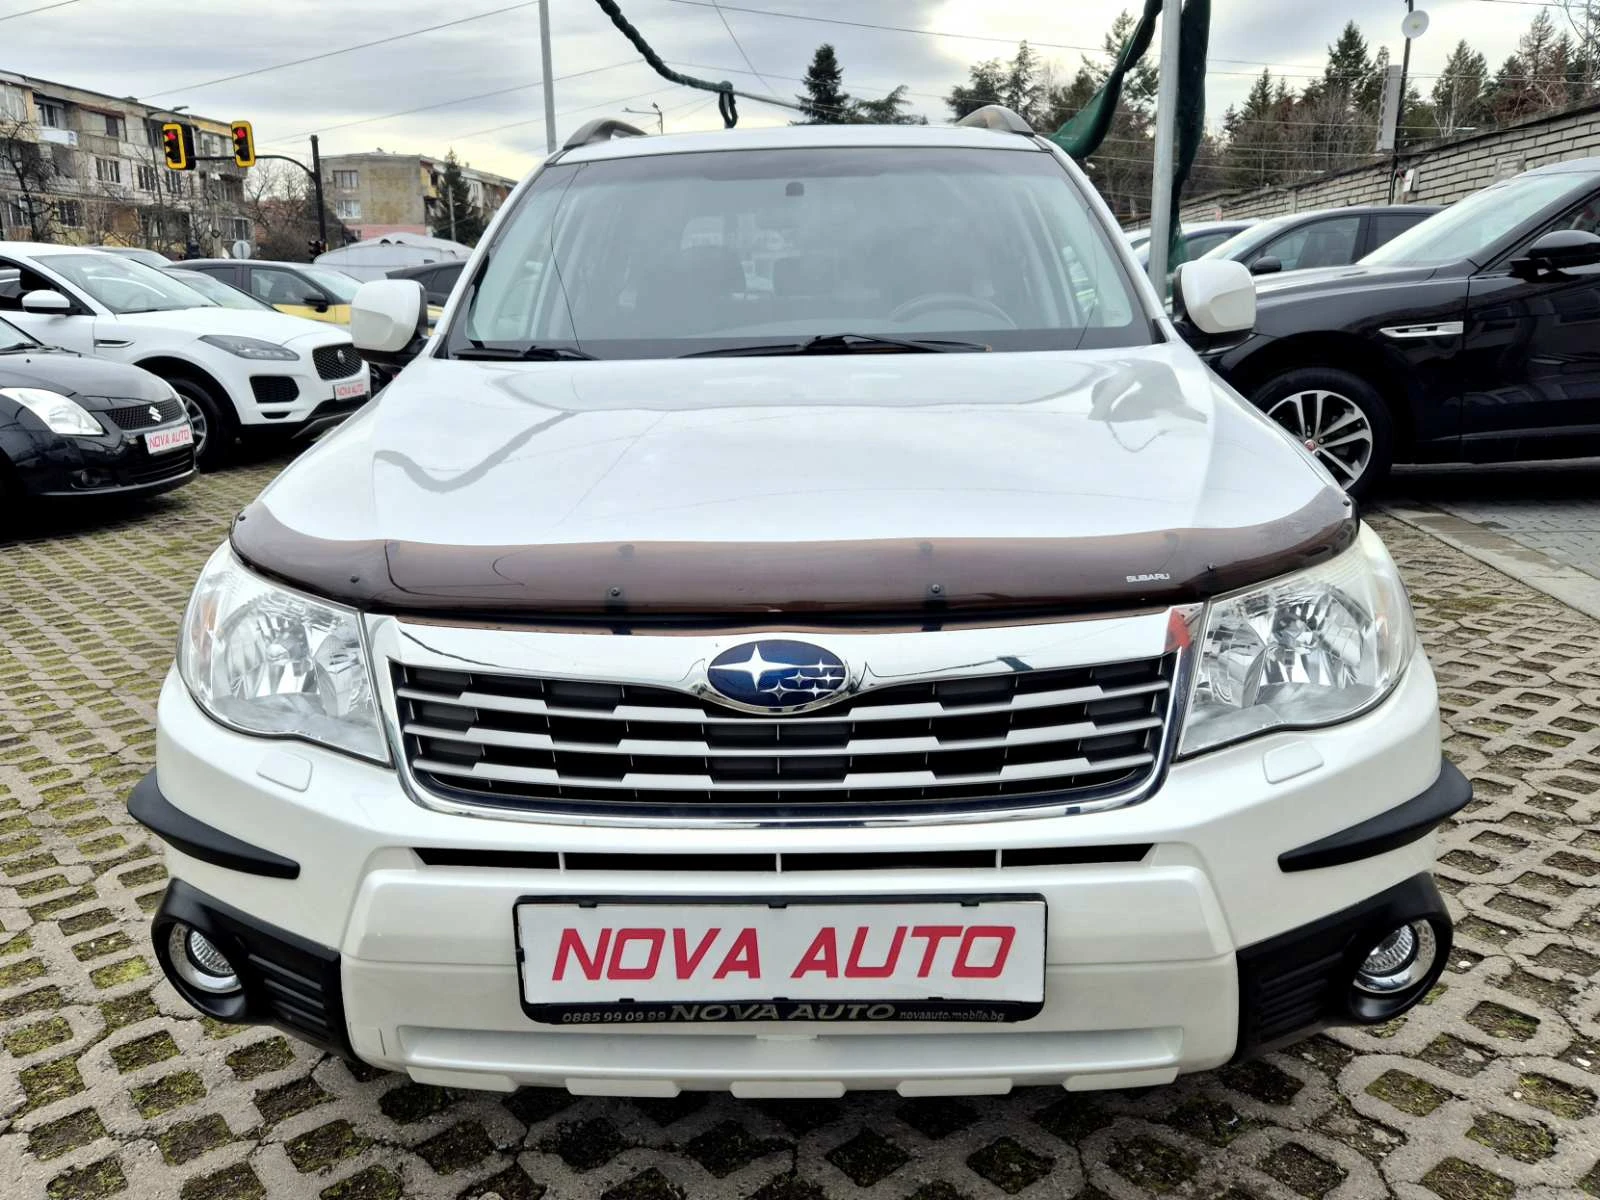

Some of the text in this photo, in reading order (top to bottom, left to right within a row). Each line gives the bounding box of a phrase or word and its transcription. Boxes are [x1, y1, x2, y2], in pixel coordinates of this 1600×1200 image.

[149, 428, 189, 449] NOVA AUTO
[1126, 573, 1170, 583] SUBARU
[552, 925, 1016, 980] NOVA AUTO
[562, 1012, 600, 1023] 0885
[603, 1012, 623, 1022] 99
[625, 1012, 644, 1022] 09
[670, 1004, 778, 1021] NOVA
[787, 1003, 896, 1020] AUTO
[900, 1010, 1005, 1023] novaauto.mobile.bg
